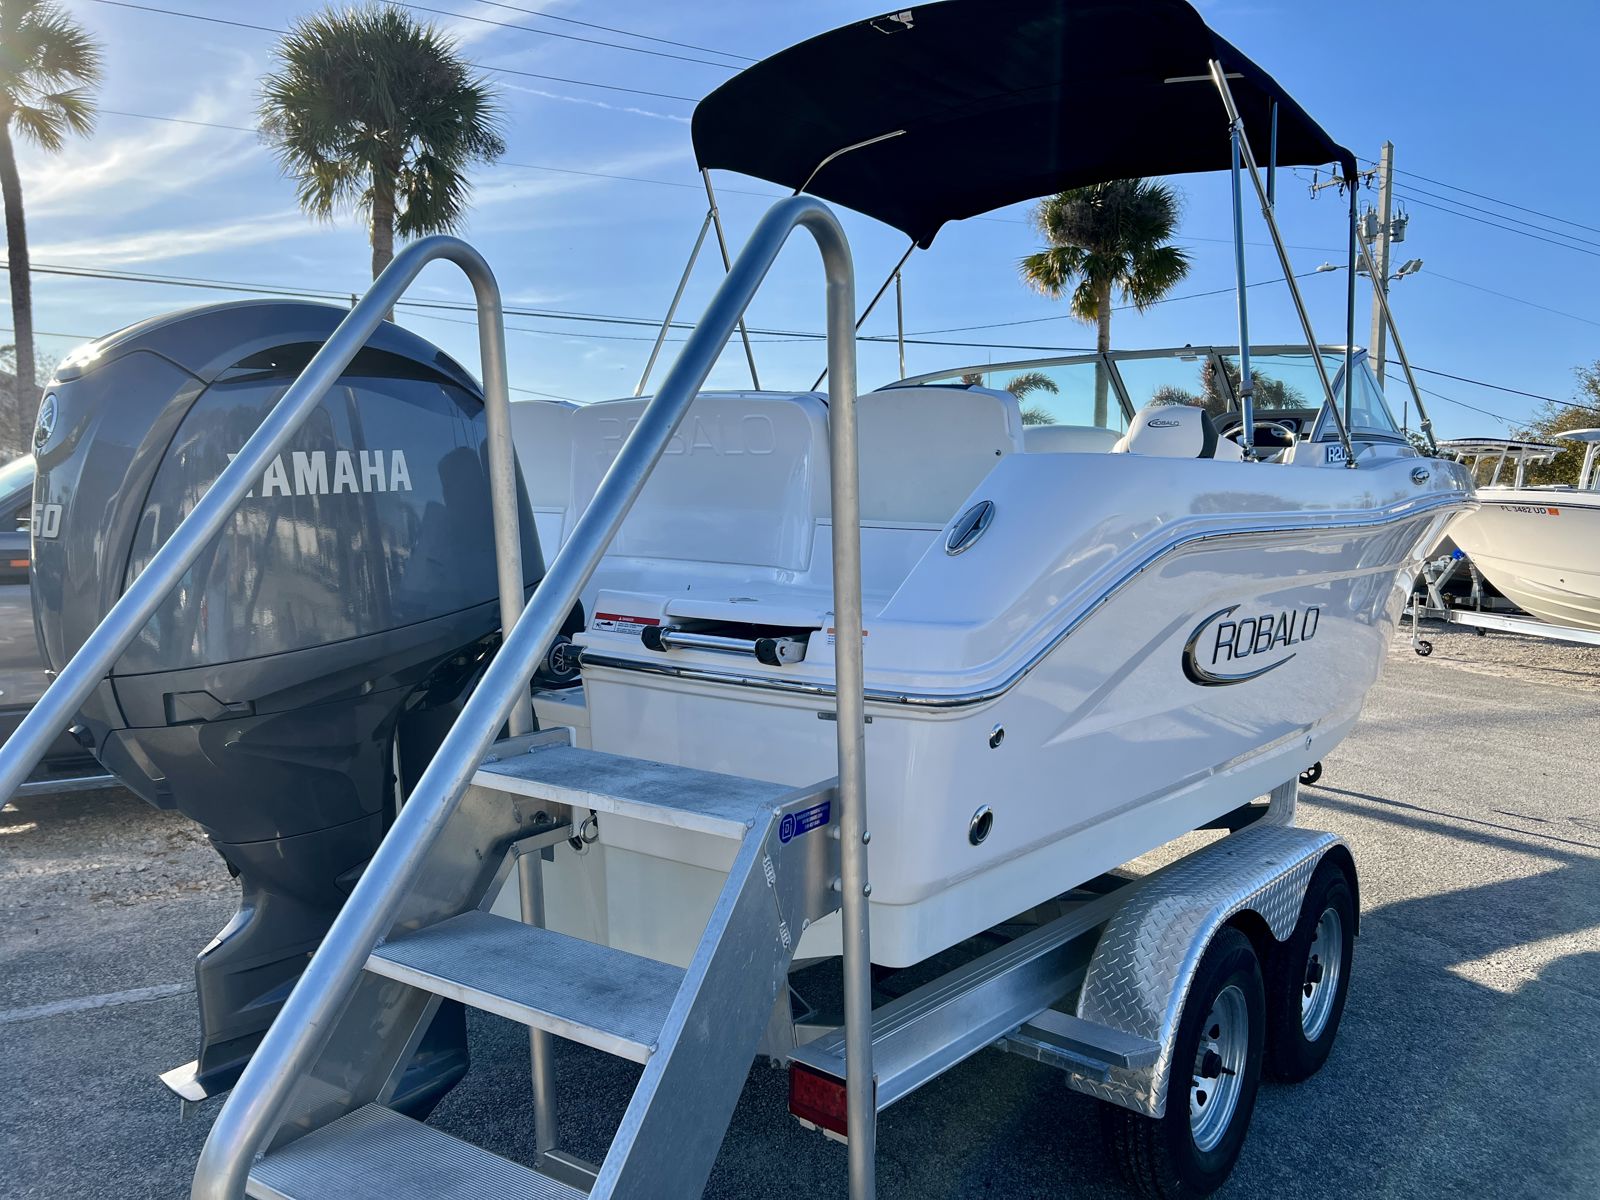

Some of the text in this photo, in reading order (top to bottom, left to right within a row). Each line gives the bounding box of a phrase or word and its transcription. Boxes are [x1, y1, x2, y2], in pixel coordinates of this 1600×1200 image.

[597, 414, 776, 456] RBALO
[227, 449, 413, 498] AMAHA
[1211, 605, 1320, 665] ROBALO
